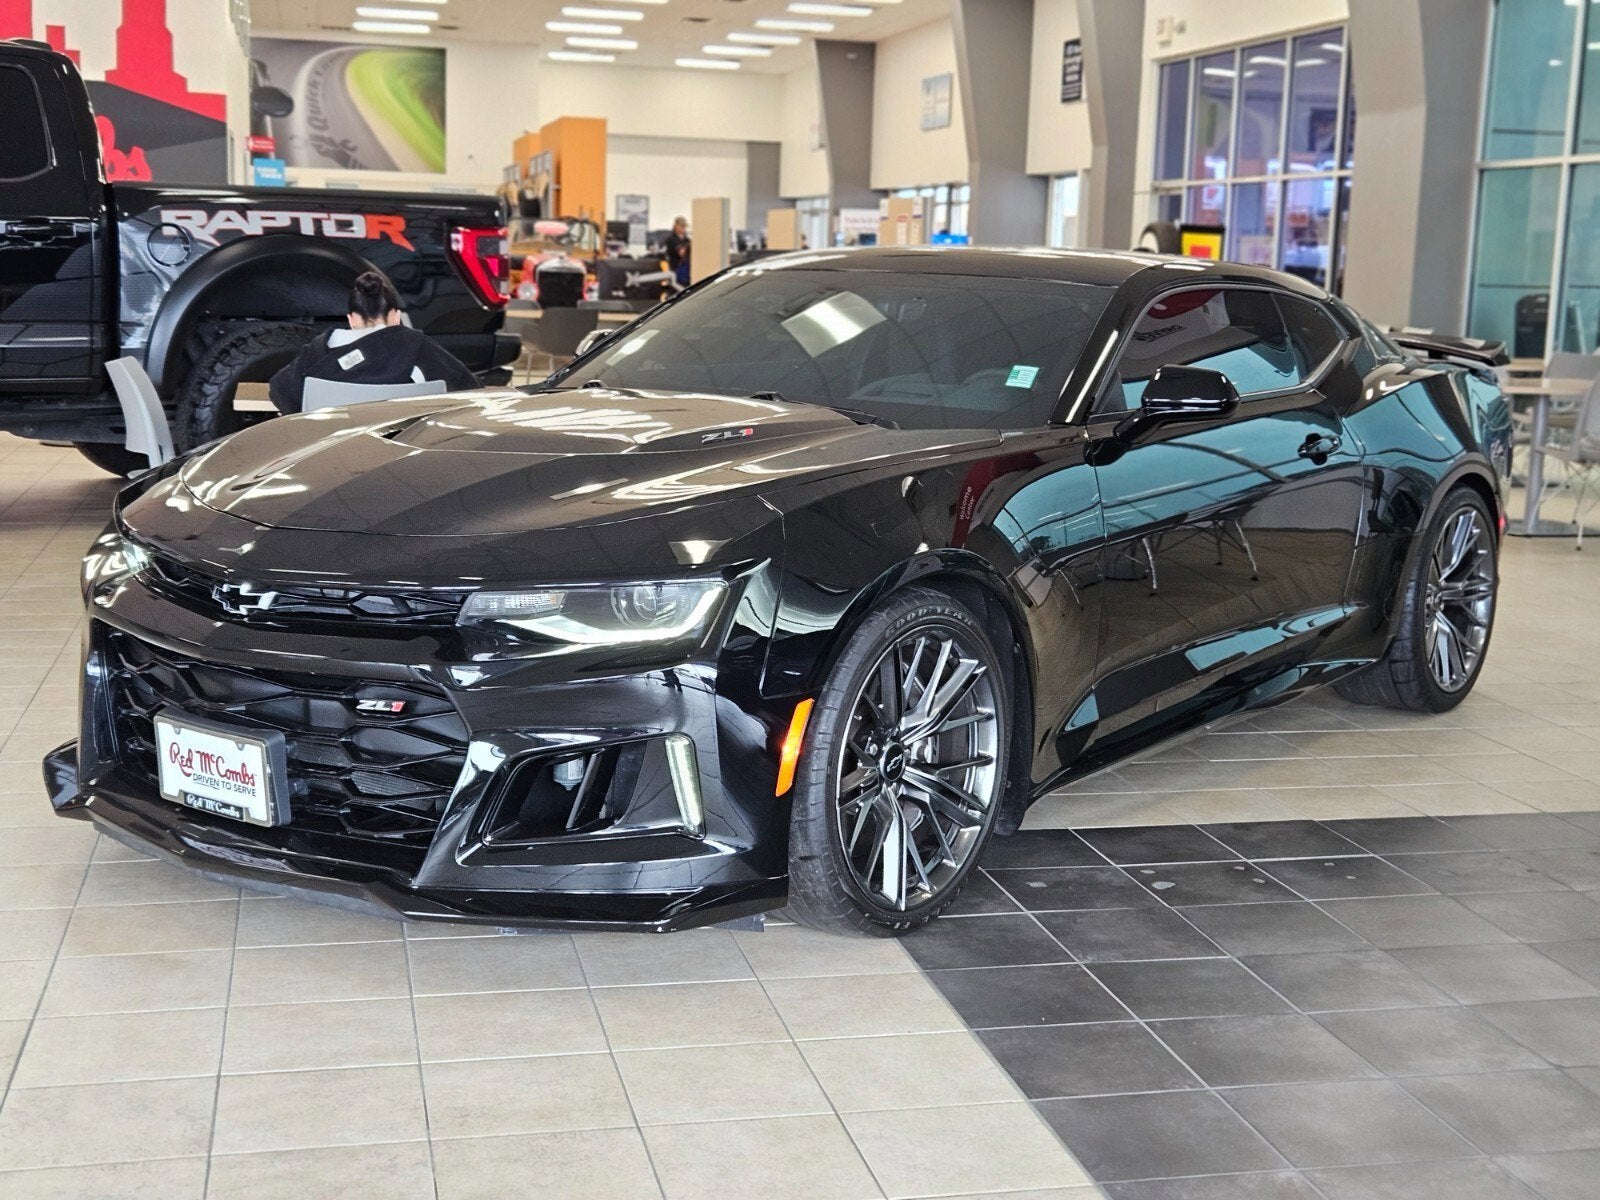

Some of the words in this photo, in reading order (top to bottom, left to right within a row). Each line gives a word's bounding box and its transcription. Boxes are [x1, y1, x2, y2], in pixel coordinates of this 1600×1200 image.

[160, 209, 415, 253] RAPTOR
[701, 428, 754, 443] ZL1
[355, 699, 407, 713] ZL1
[169, 742, 195, 777] Red
[195, 751, 255, 786] McCombs
[193, 773, 220, 787] DRIVEN
[221, 780, 231, 791] TO
[233, 784, 257, 797] SERVE
[186, 793, 203, 808] Red
[203, 797, 240, 817] McCombs
